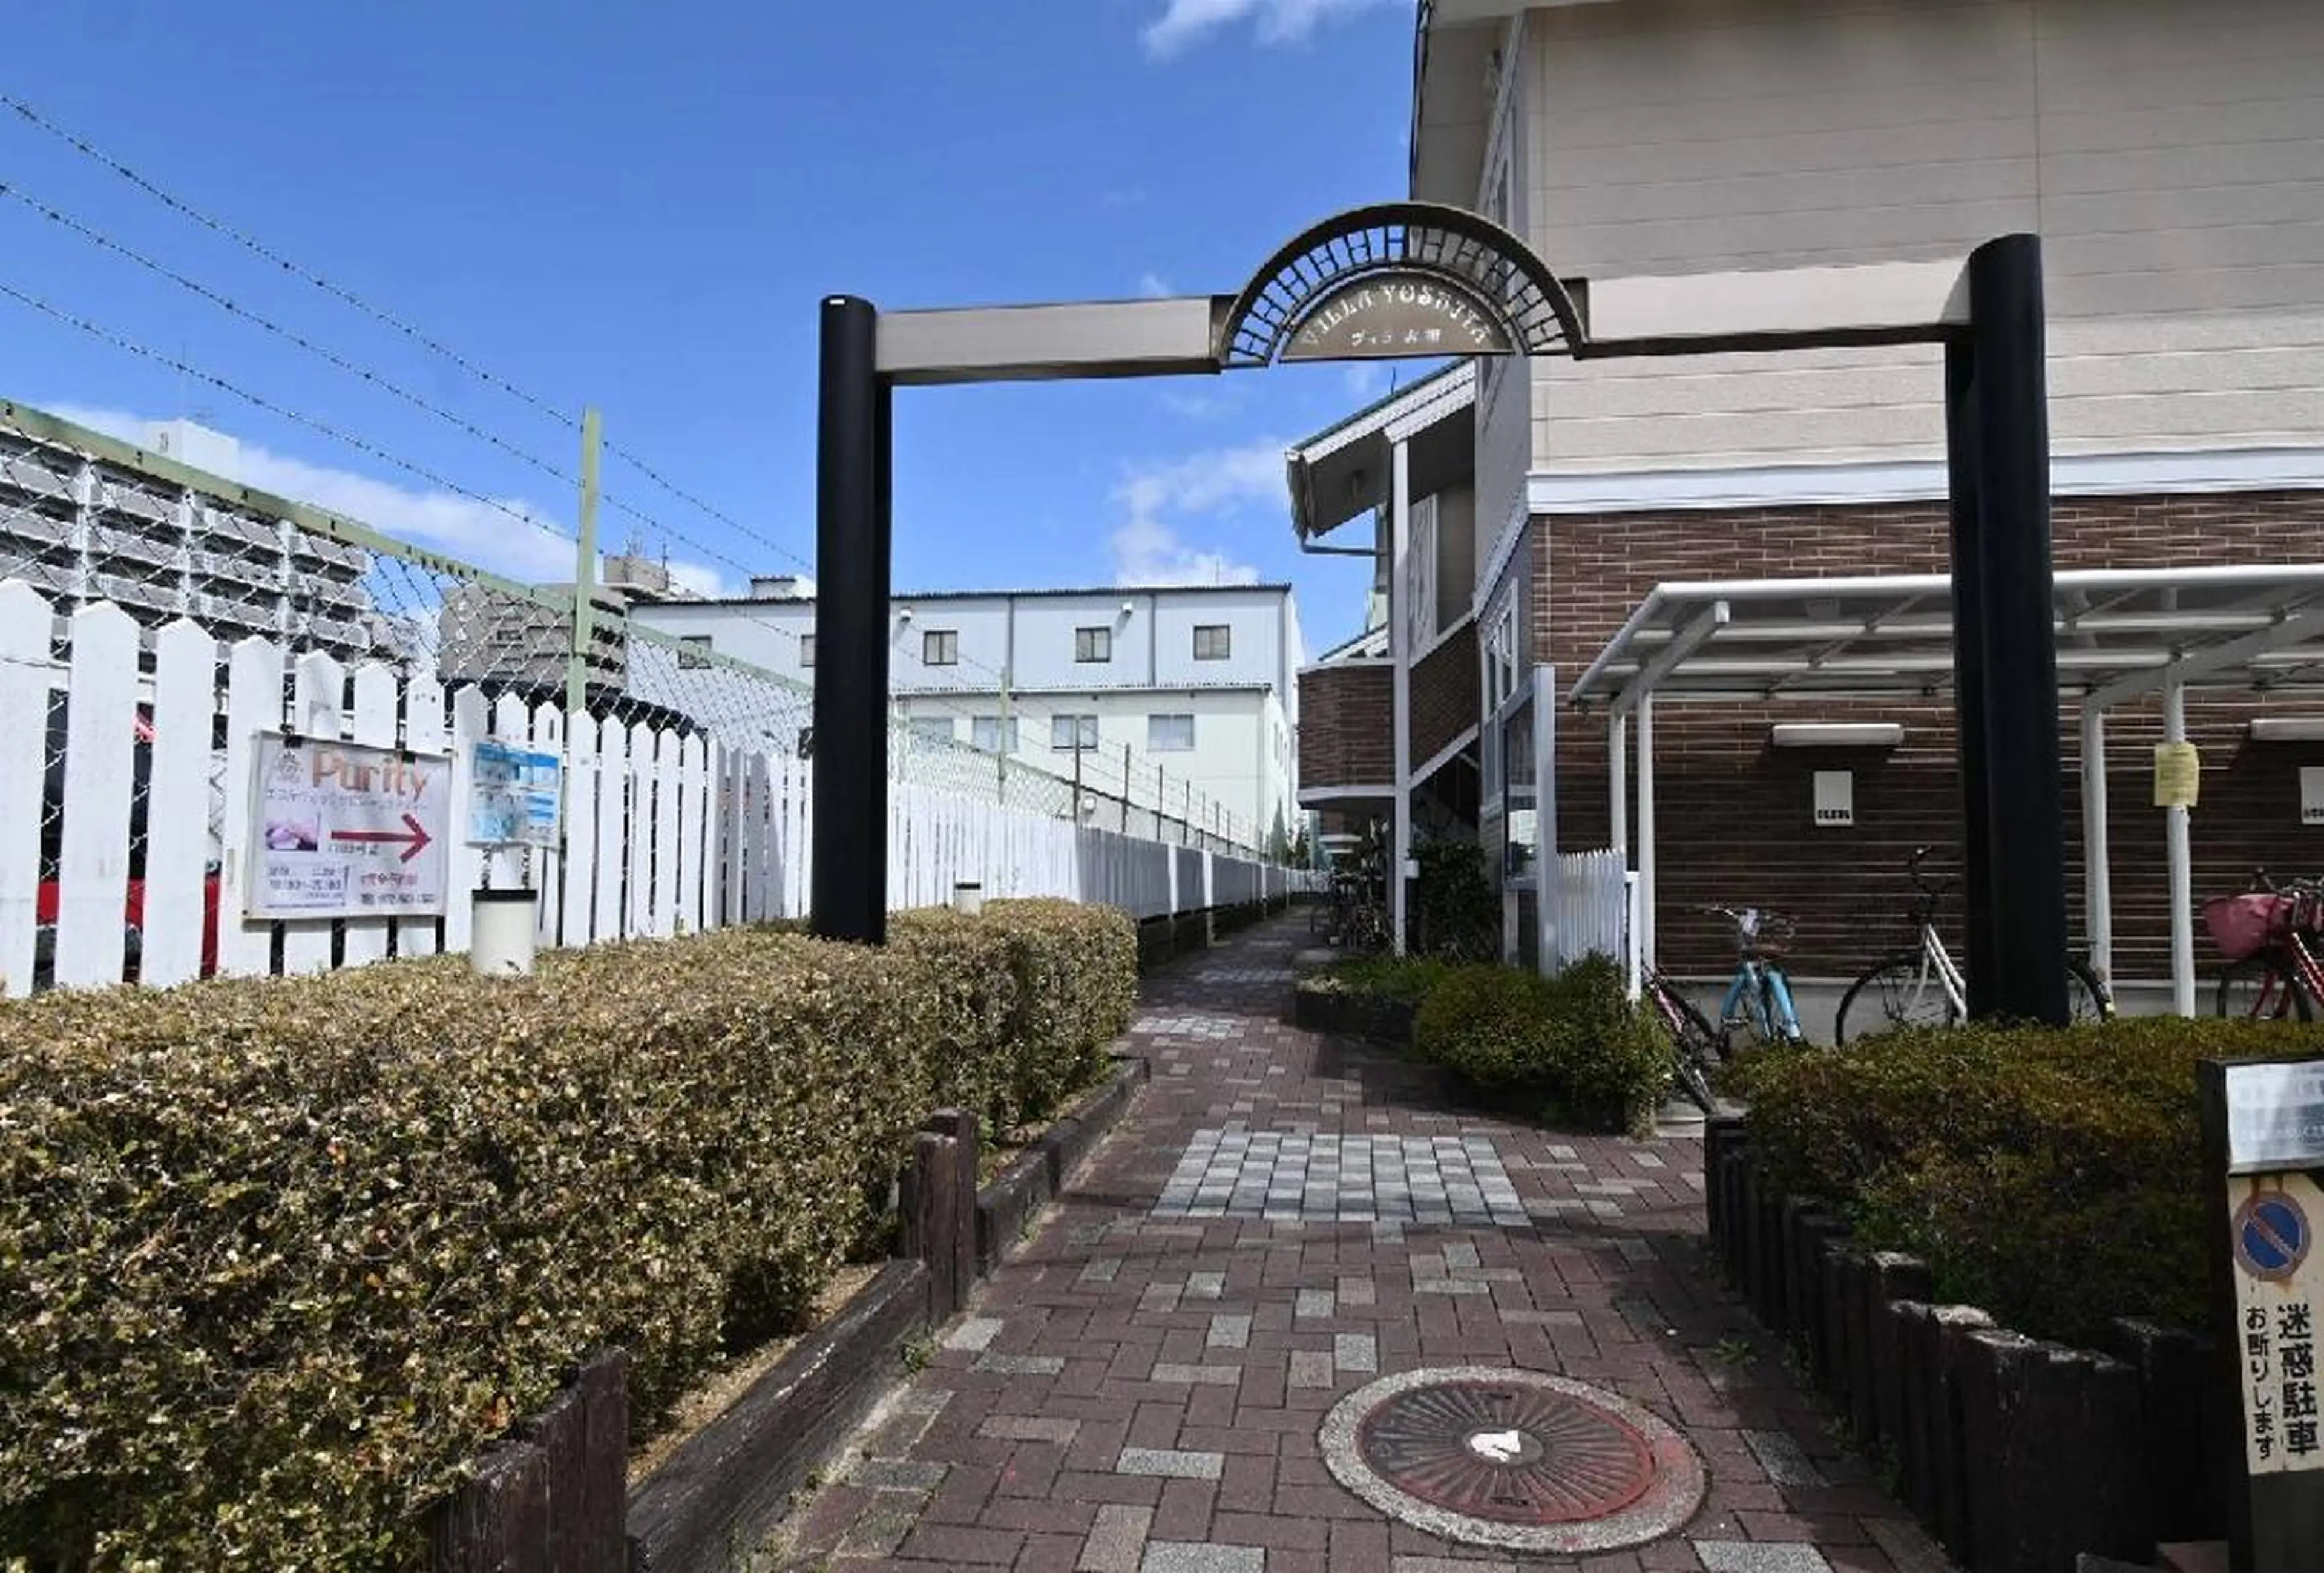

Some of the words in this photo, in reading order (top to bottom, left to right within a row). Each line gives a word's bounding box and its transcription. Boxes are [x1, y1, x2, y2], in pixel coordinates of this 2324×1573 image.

[312, 746, 430, 803] Purity
[2246, 1306, 2274, 1460] お断りします
[2277, 1302, 2320, 1456] 迷惑駐車
